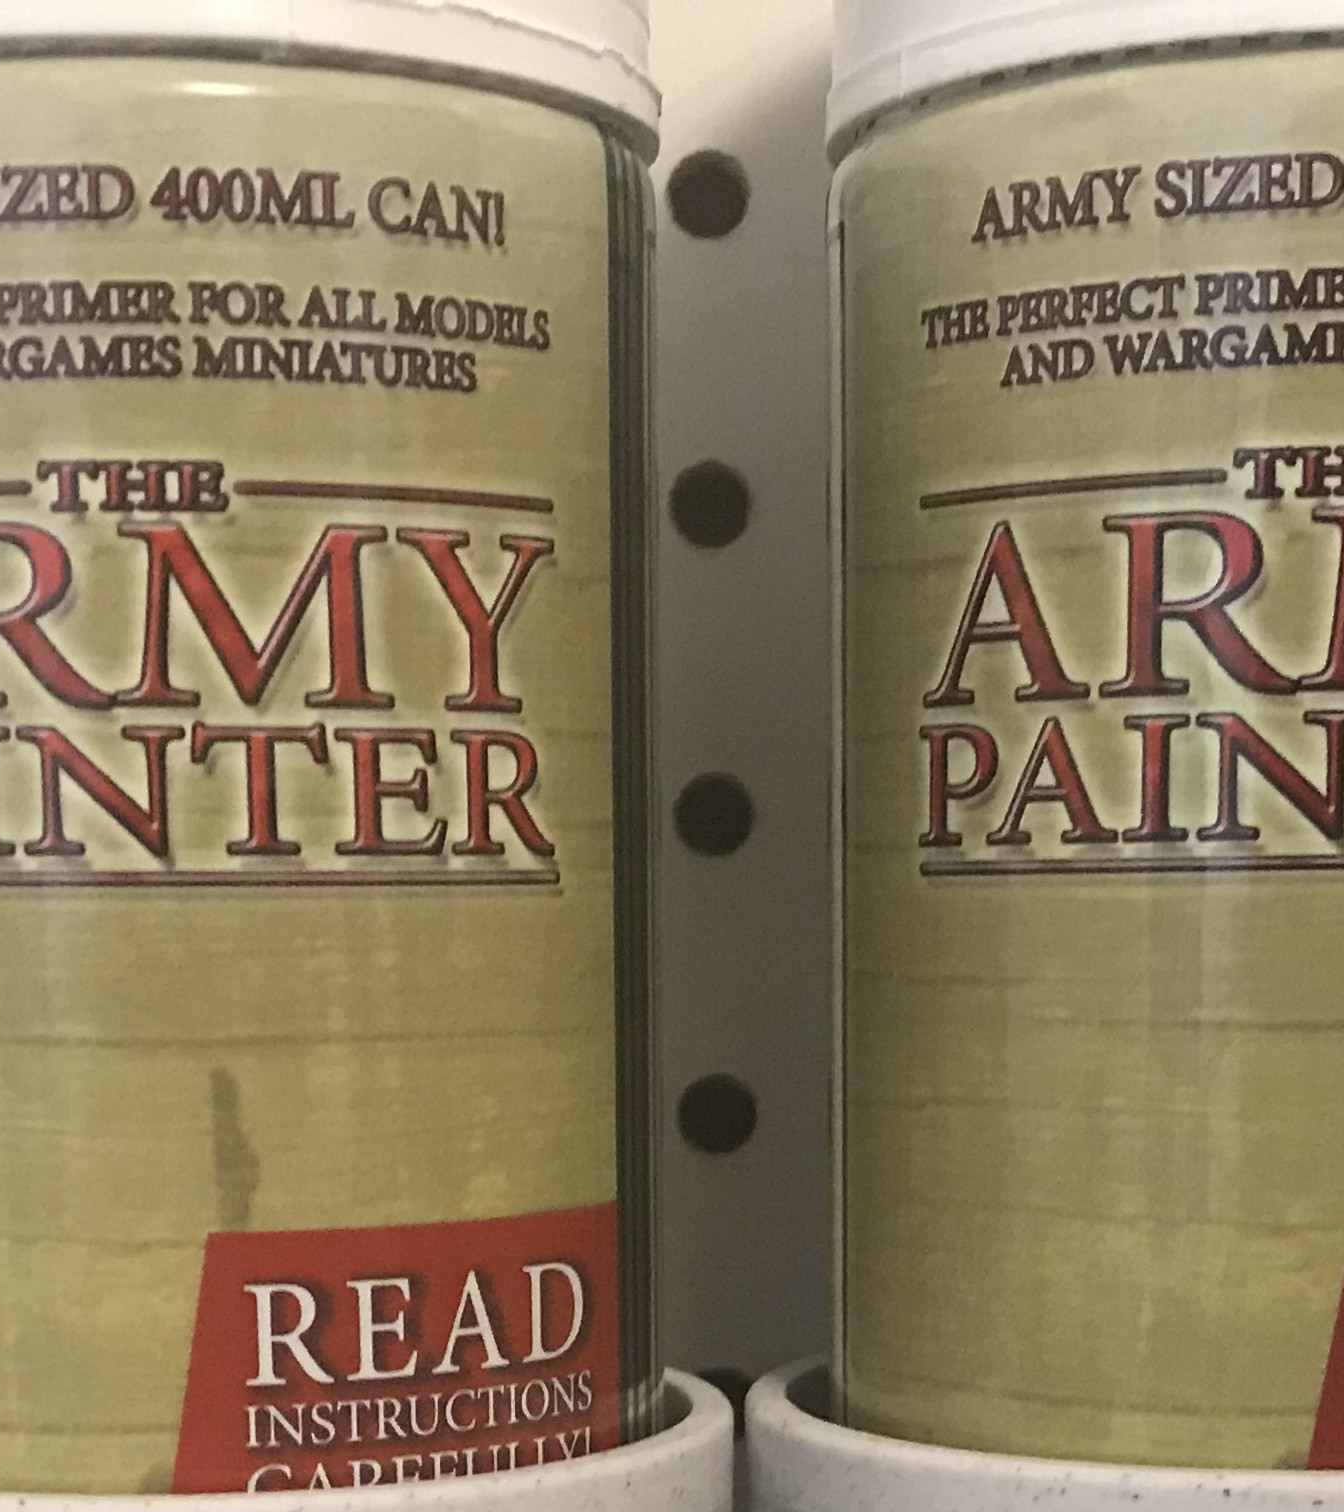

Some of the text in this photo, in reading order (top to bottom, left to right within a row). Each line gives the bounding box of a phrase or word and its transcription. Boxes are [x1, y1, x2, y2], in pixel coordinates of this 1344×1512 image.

[150, 166, 355, 228] 400ML
[368, 178, 509, 248] CAN!
[971, 166, 1141, 243] ARMY
[190, 282, 288, 327] FOR
[300, 289, 384, 335] ALL
[395, 295, 550, 352] MODELS
[922, 302, 989, 349] THE
[997, 275, 1185, 338] PERFECT
[193, 338, 479, 394] MINIATURES
[1001, 336, 1095, 389] AND
[36, 459, 231, 514] THE
[243, 1262, 587, 1387] READ
[244, 1370, 593, 1449] INSTRUCTIONS
